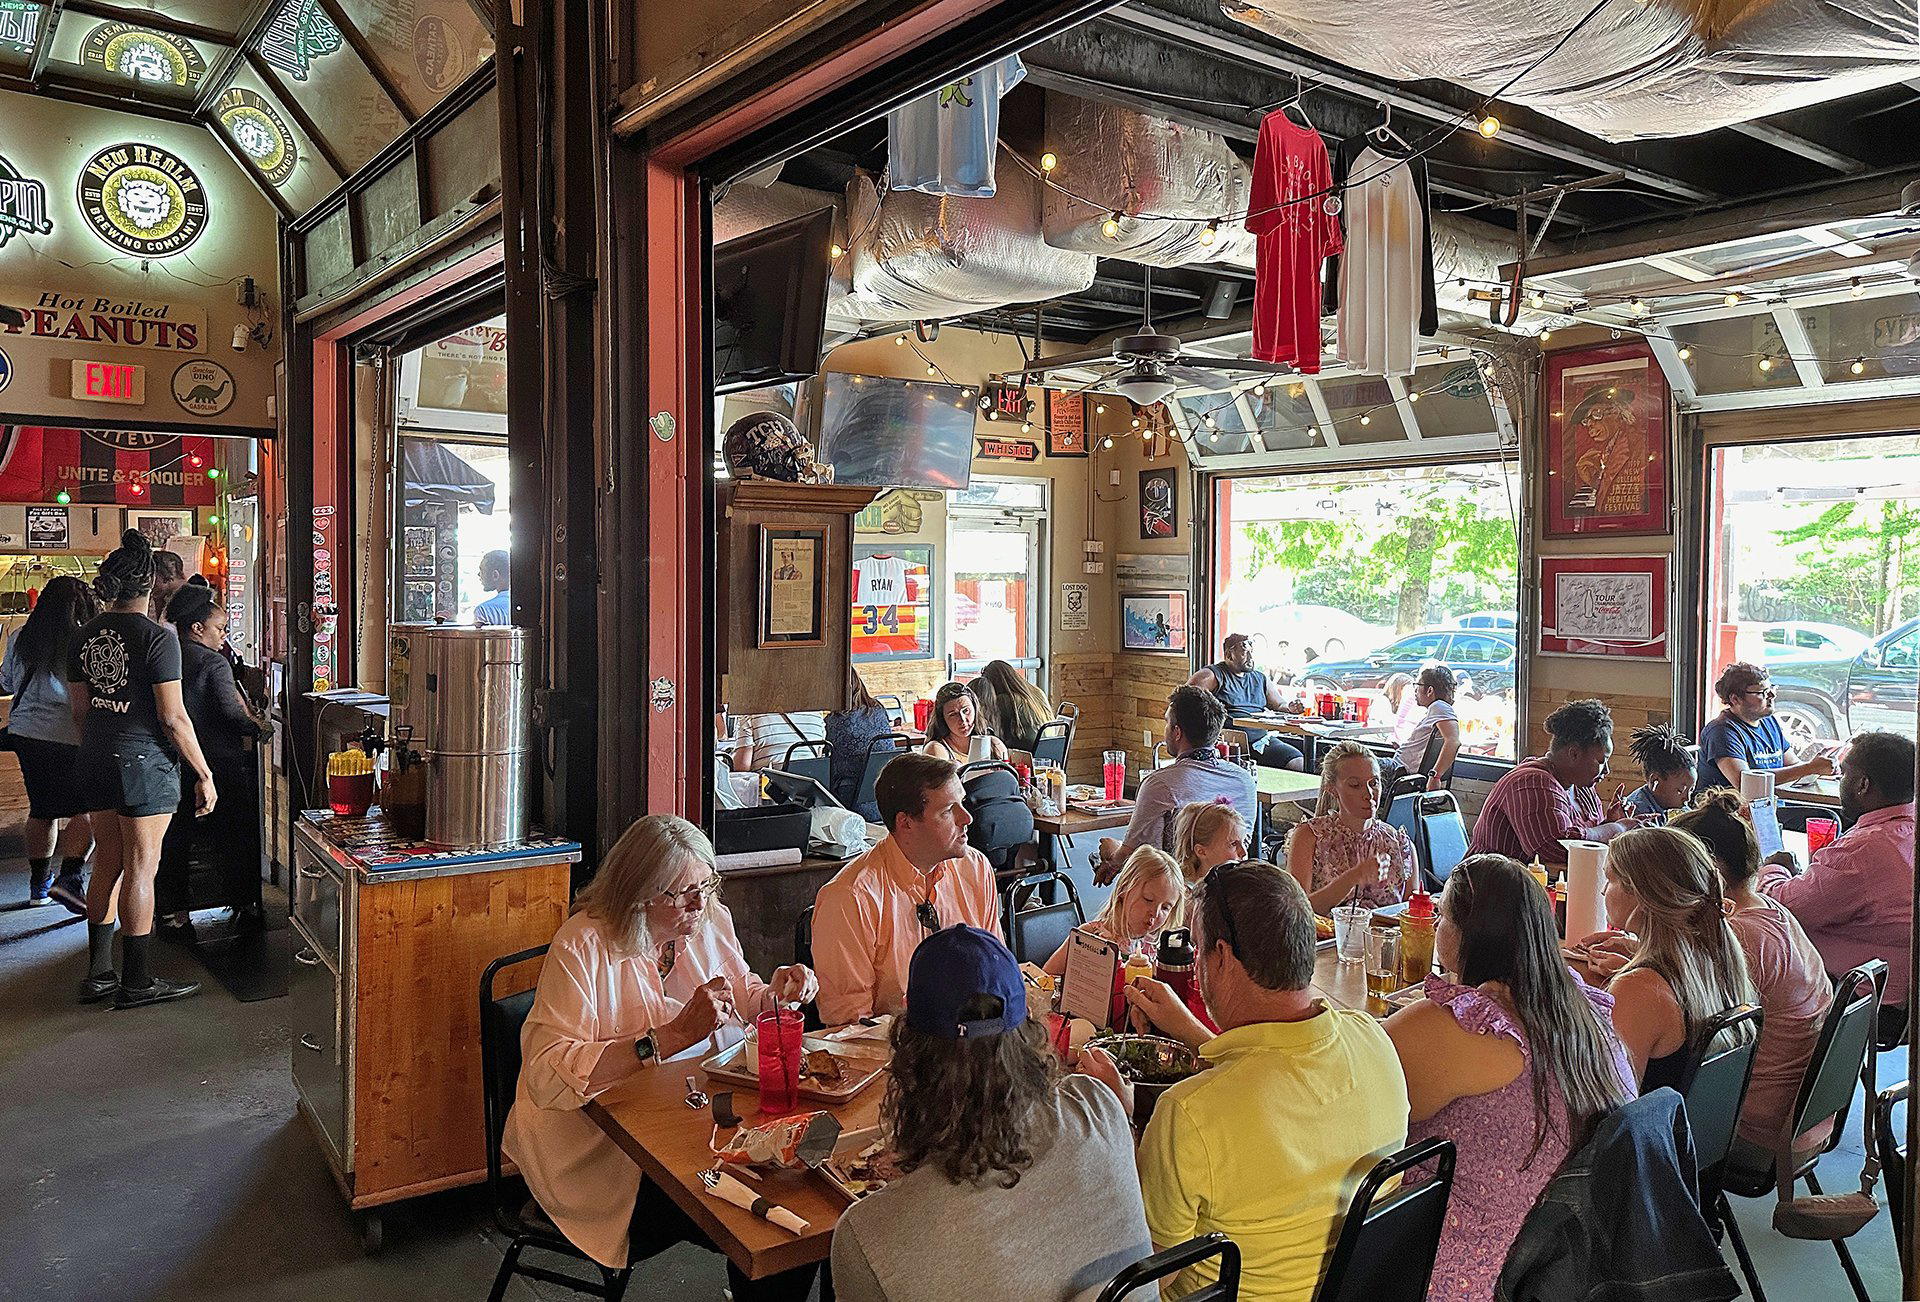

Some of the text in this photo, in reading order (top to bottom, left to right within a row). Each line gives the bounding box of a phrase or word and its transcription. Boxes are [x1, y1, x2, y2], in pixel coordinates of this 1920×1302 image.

[87, 145, 199, 194] NEW REALM
[89, 206, 198, 252] BREWING COMPANY
[37, 291, 170, 319] Hot Boiled
[437, 351, 468, 359] THERE'S
[86, 362, 136, 399] EXIT
[193, 373, 214, 381] DINO
[188, 403, 218, 412] GASOLINE
[745, 419, 786, 446] TCU
[987, 443, 1032, 456] WHISTLE
[57, 465, 204, 487] UNITE & CONQUER
[1610, 483, 1632, 496] JAZZ
[1607, 495, 1641, 503] HERITAGE
[1604, 503, 1641, 512] FESTIVAL
[870, 579, 894, 592] RYAN
[1595, 594, 1616, 602] TOUR
[862, 605, 899, 635] 34
[91, 696, 131, 714] CREW
